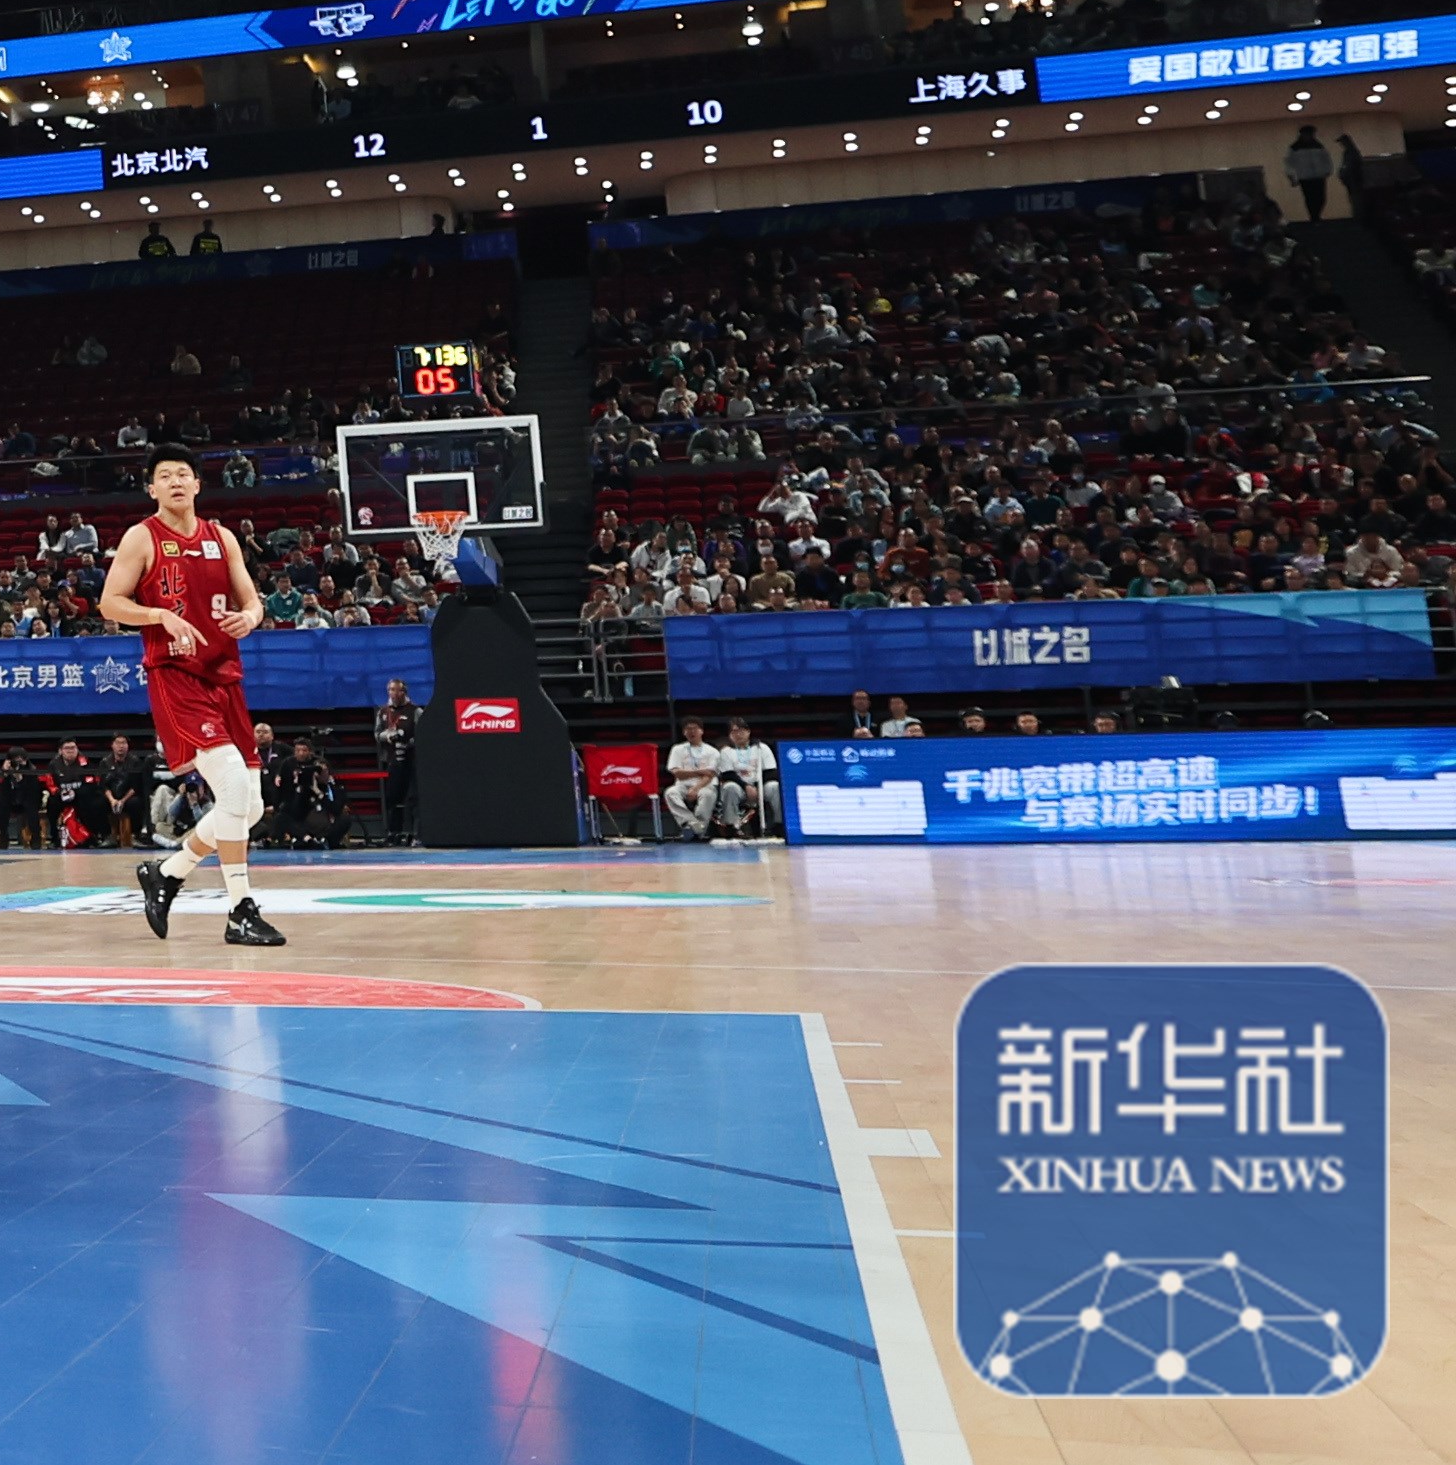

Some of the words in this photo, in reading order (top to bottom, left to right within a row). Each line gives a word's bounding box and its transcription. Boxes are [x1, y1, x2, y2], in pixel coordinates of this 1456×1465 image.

[1128, 30, 1419, 86] 爱国敬业奋发图强
[908, 67, 1028, 105] 上海久事
[686, 98, 723, 127] 10
[530, 117, 549, 142] 1
[352, 132, 387, 160] 12
[110, 145, 210, 179] 北京北汽
[414, 368, 457, 395] 05
[210, 593, 227, 620] 9
[971, 625, 1091, 668] 以城之名
[460, 718, 517, 731] LI-NING
[599, 775, 644, 785] LI-NING
[942, 755, 1220, 805] 千兆宽带超高速
[1019, 782, 1321, 833] 与赛场实时同步!
